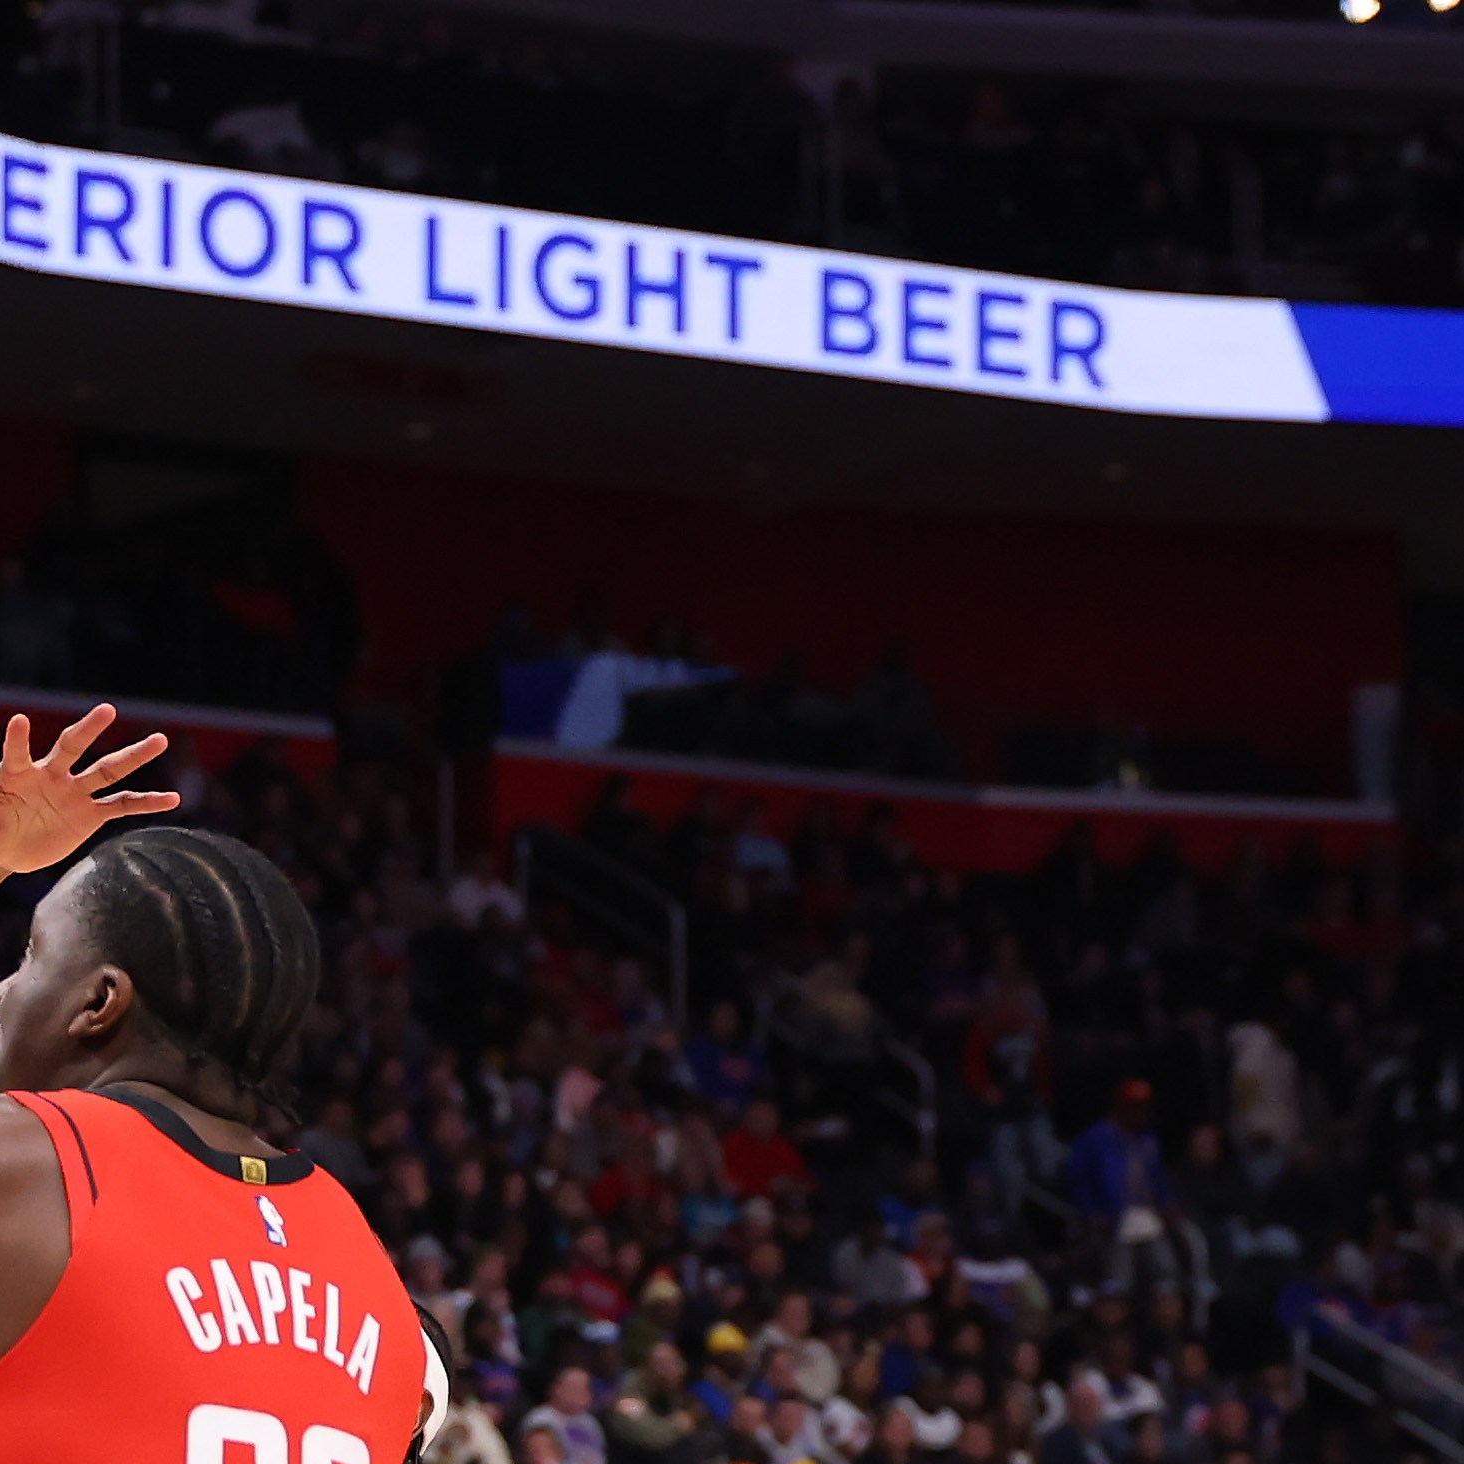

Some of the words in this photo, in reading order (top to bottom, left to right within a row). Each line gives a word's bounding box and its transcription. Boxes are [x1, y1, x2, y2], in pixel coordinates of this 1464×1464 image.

[422, 212, 766, 344] LIGHT
[817, 265, 1109, 391] BEER
[165, 1258, 381, 1396] CAPELA
